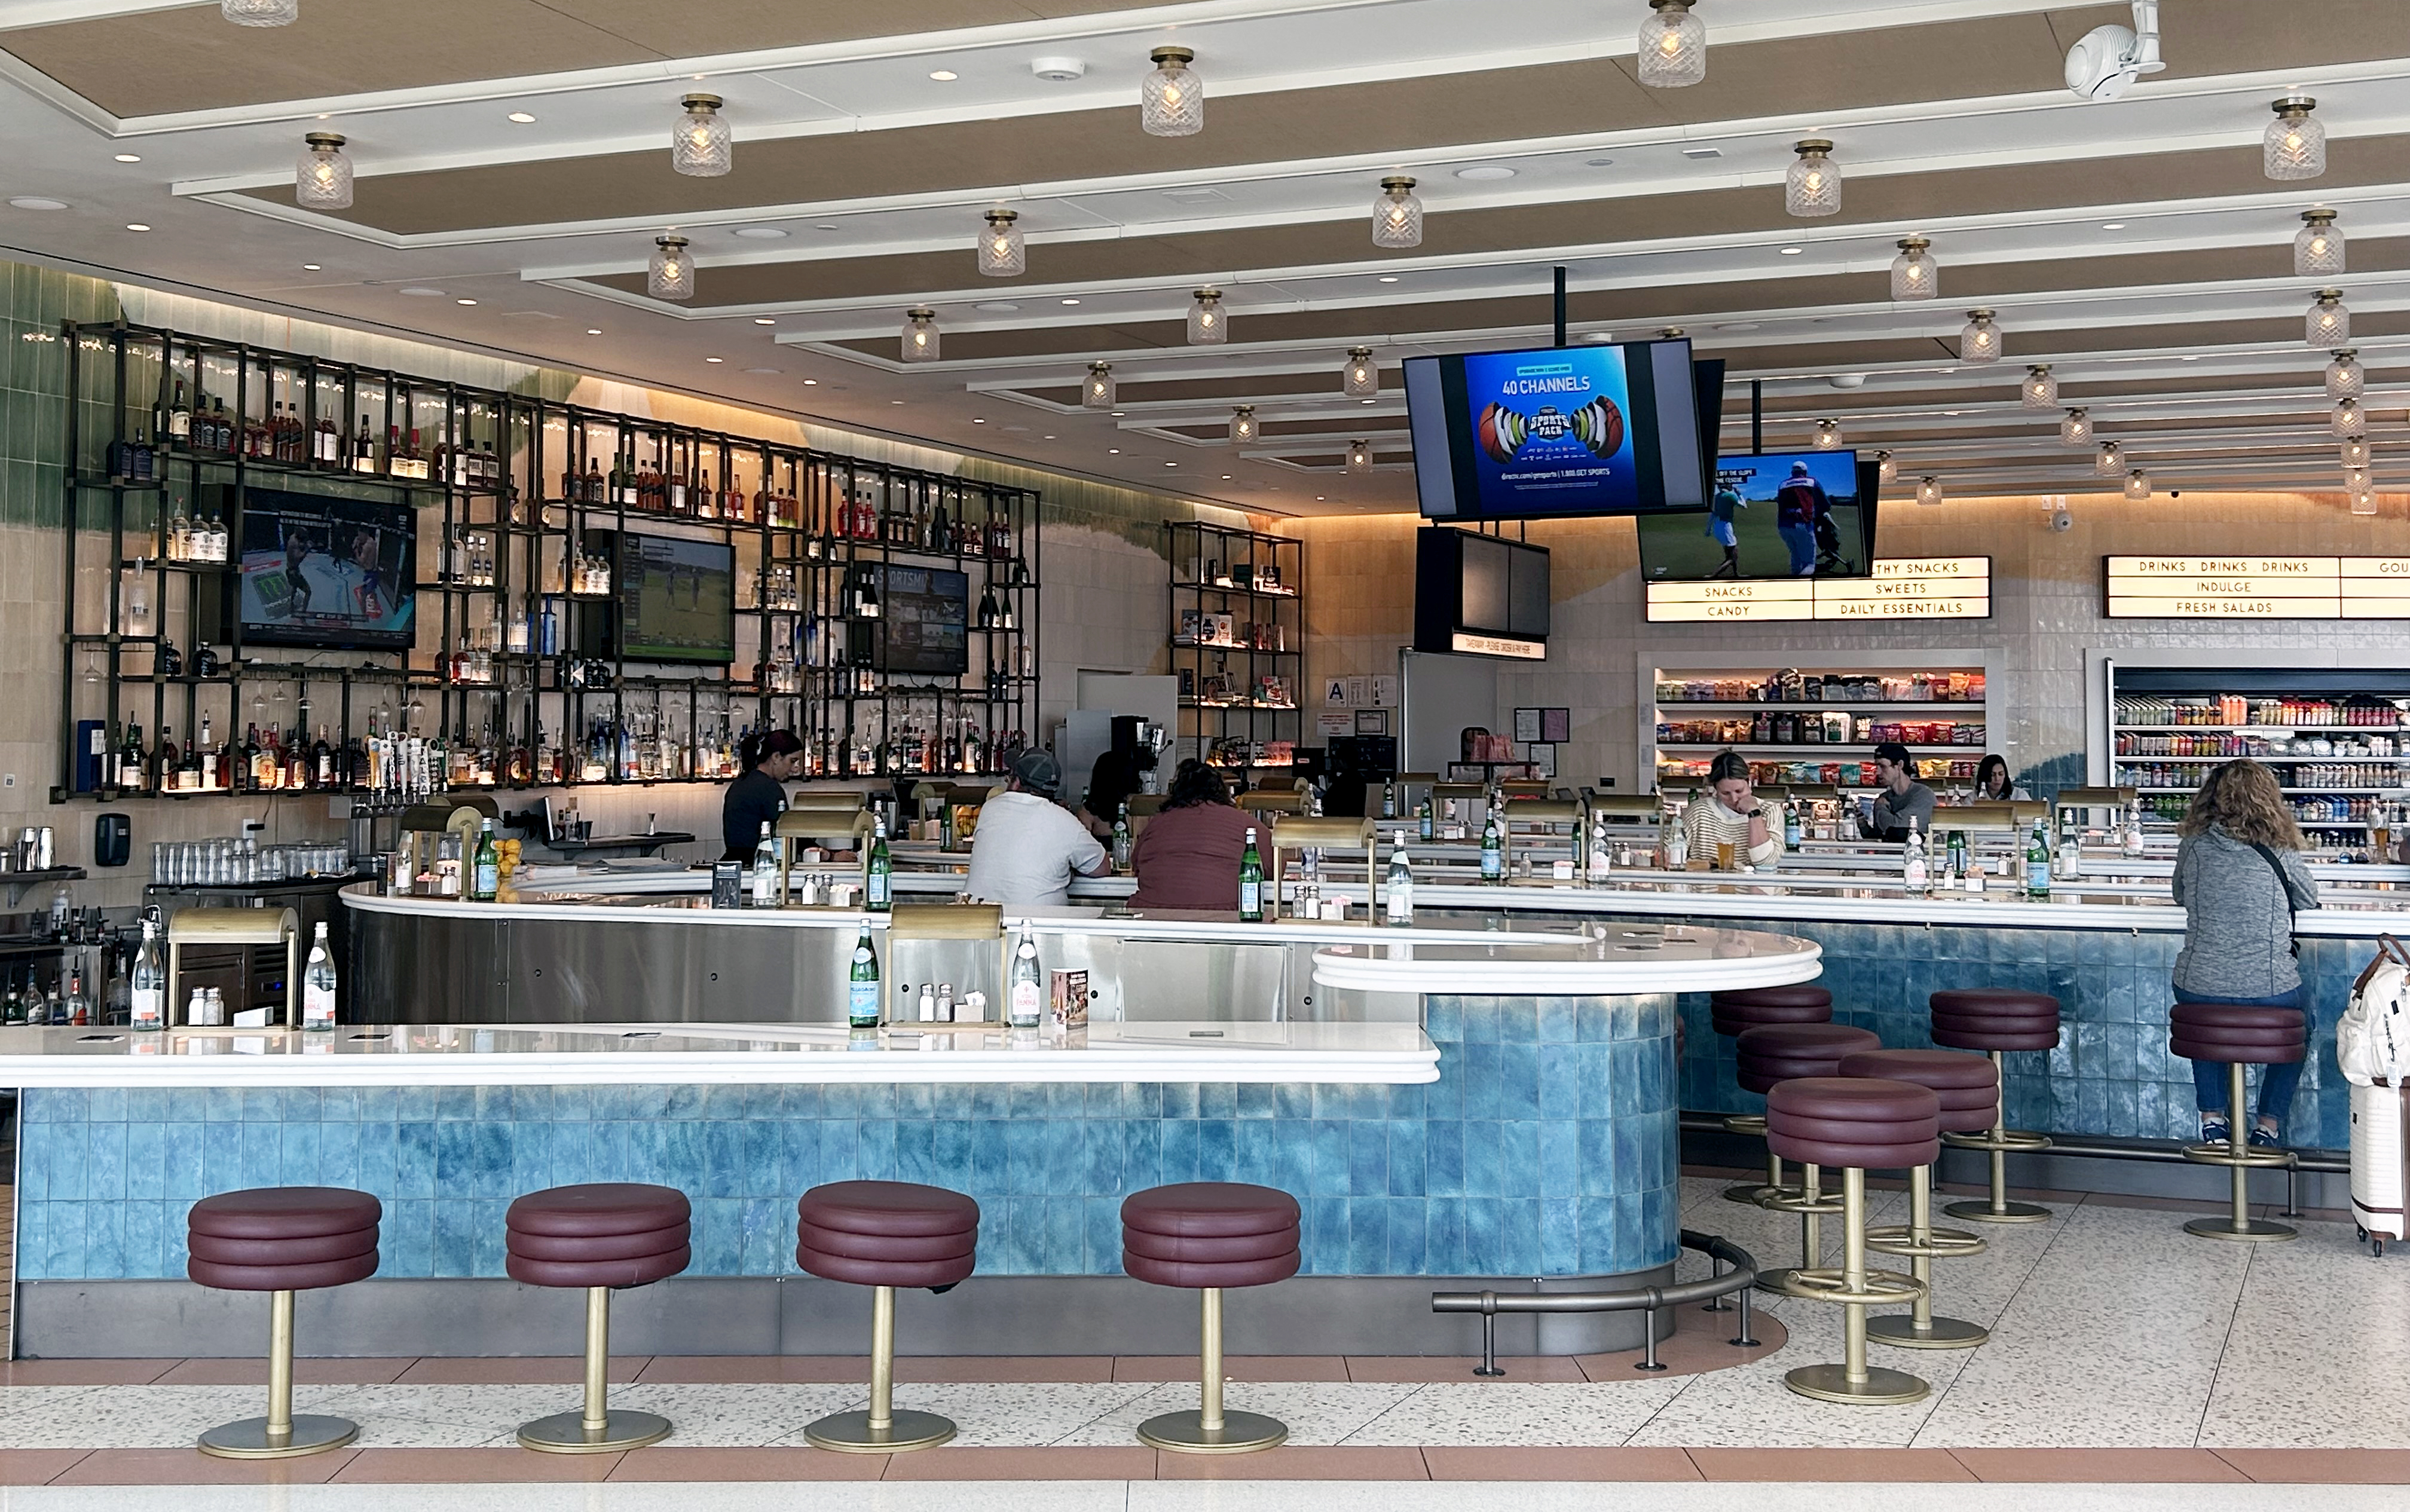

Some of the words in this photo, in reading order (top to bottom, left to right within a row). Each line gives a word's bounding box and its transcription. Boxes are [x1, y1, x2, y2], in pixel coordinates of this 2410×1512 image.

[1503, 380, 1518, 395] 40
[1519, 375, 1591, 394] CHANNELS
[1530, 415, 1571, 430] SPORTS
[1539, 426, 1562, 436] PACK
[1907, 562, 1959, 574] SNACKS
[2140, 562, 2186, 572] DRINKS
[2201, 562, 2247, 572] DRINKS
[2262, 562, 2308, 572] DRINKS
[2380, 562, 2409, 573] GOU
[877, 569, 927, 587] SORTSMI
[1705, 587, 1753, 597] SNACKS
[1876, 583, 1926, 594] SWEETS
[2197, 582, 2251, 592] INDULGE
[1708, 606, 1750, 616] CANDY
[1841, 604, 1876, 615] DAILY
[1883, 602, 1963, 614] ESSENTIALS
[2177, 602, 2216, 613] FRESH
[2223, 602, 2272, 613] SALADS
[1329, 682, 1344, 700] A
